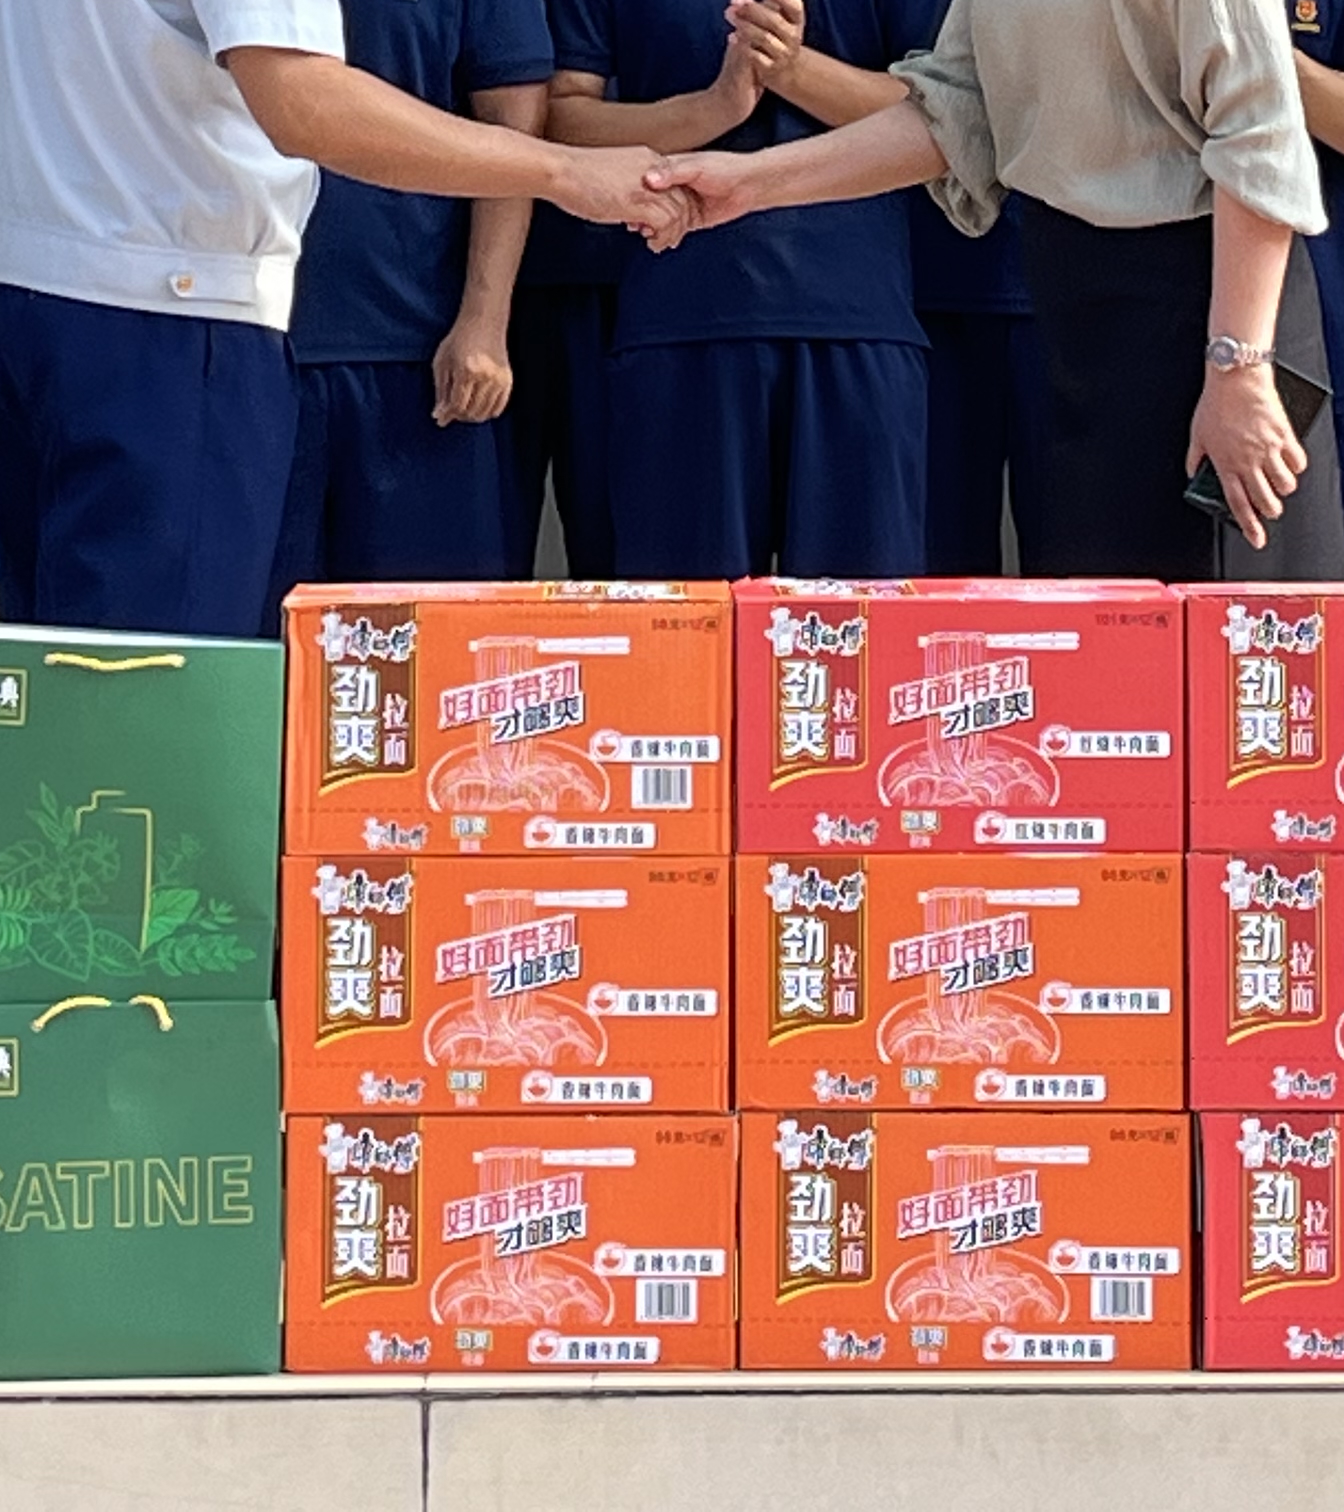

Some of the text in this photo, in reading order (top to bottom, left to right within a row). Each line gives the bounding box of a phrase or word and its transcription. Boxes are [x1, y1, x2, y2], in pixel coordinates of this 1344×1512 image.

[332, 665, 380, 764] 劲爽
[442, 667, 578, 726] 好面带劲
[781, 660, 829, 759] 劲爽
[833, 688, 858, 761] 拉面
[892, 662, 1028, 721] 好面带劲
[1237, 658, 1285, 757] 劲爽
[1289, 686, 1314, 759] 拉面
[384, 693, 409, 766] 拉面
[327, 918, 375, 1017] 劲爽
[379, 946, 404, 1019] 拉面
[439, 920, 575, 979] 好面带劲
[780, 916, 828, 1015] 劲爽
[832, 944, 857, 1017] 拉面
[892, 918, 1028, 977] 好面带劲
[1238, 914, 1286, 1013] 劲爽
[1290, 942, 1315, 1015] 拉面
[334, 1178, 382, 1277] 劲爽
[386, 1206, 411, 1279] 拉面
[445, 1180, 581, 1239] 好面带劲
[788, 1175, 836, 1274] 劲爽
[840, 1203, 865, 1276] 拉面
[900, 1177, 1036, 1236] 好面带劲
[1251, 1173, 1299, 1272] 劲爽
[1303, 1201, 1328, 1274] 拉面
